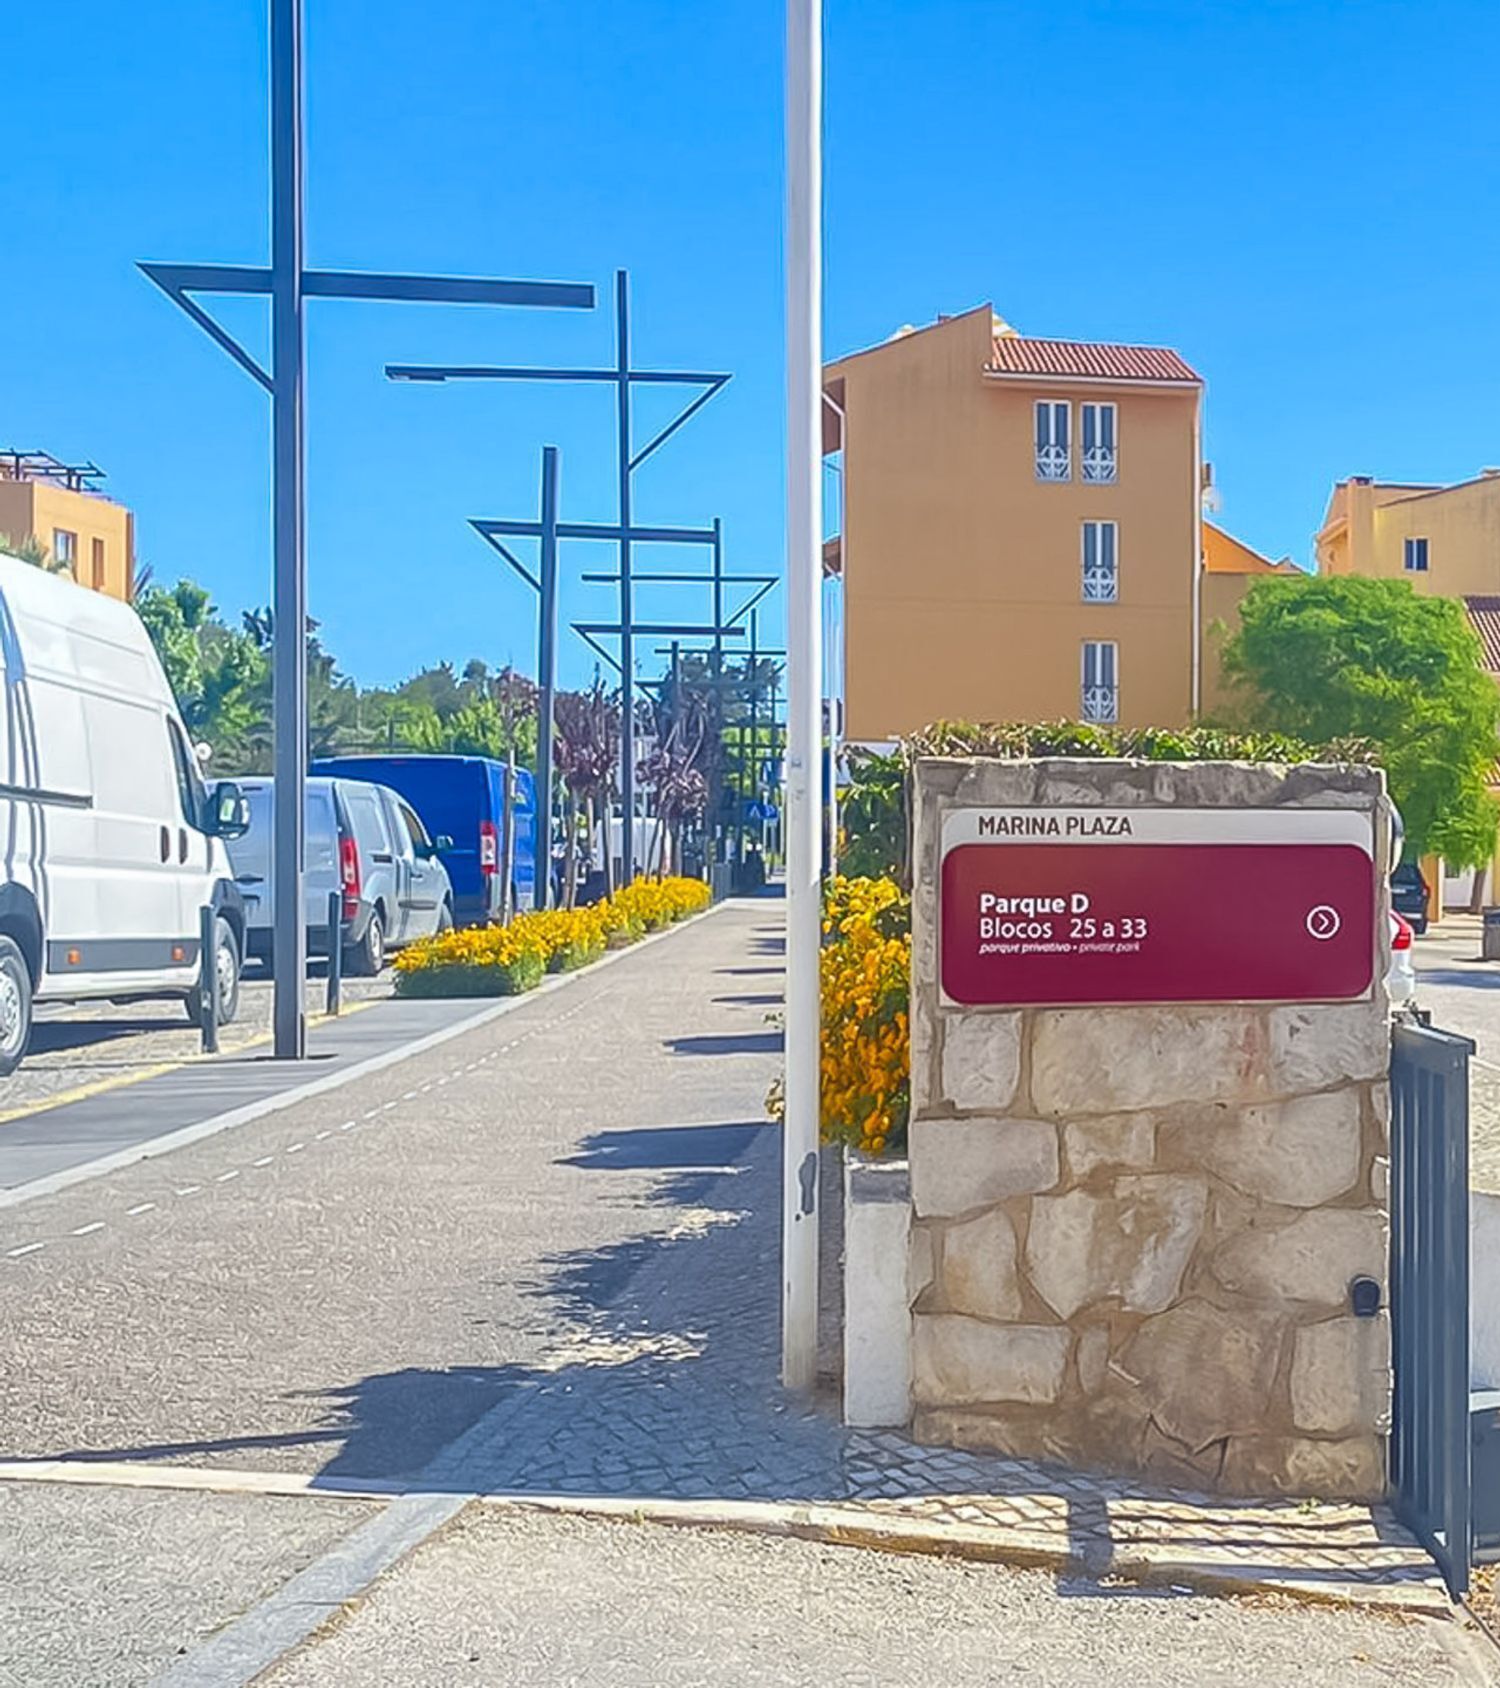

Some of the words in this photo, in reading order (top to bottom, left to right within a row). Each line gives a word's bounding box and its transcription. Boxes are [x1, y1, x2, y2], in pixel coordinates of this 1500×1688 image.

[978, 815, 1060, 836] MARINA
[1066, 816, 1133, 836] PLAZA
[979, 893, 1066, 918] Parque
[1071, 894, 1089, 914] D
[980, 918, 1053, 938] Blocos
[1070, 918, 1097, 938] 25
[1102, 922, 1115, 938] a
[1120, 918, 1148, 938] 33
[979, 942, 1019, 954] parque
[1021, 942, 1071, 954] privativo
